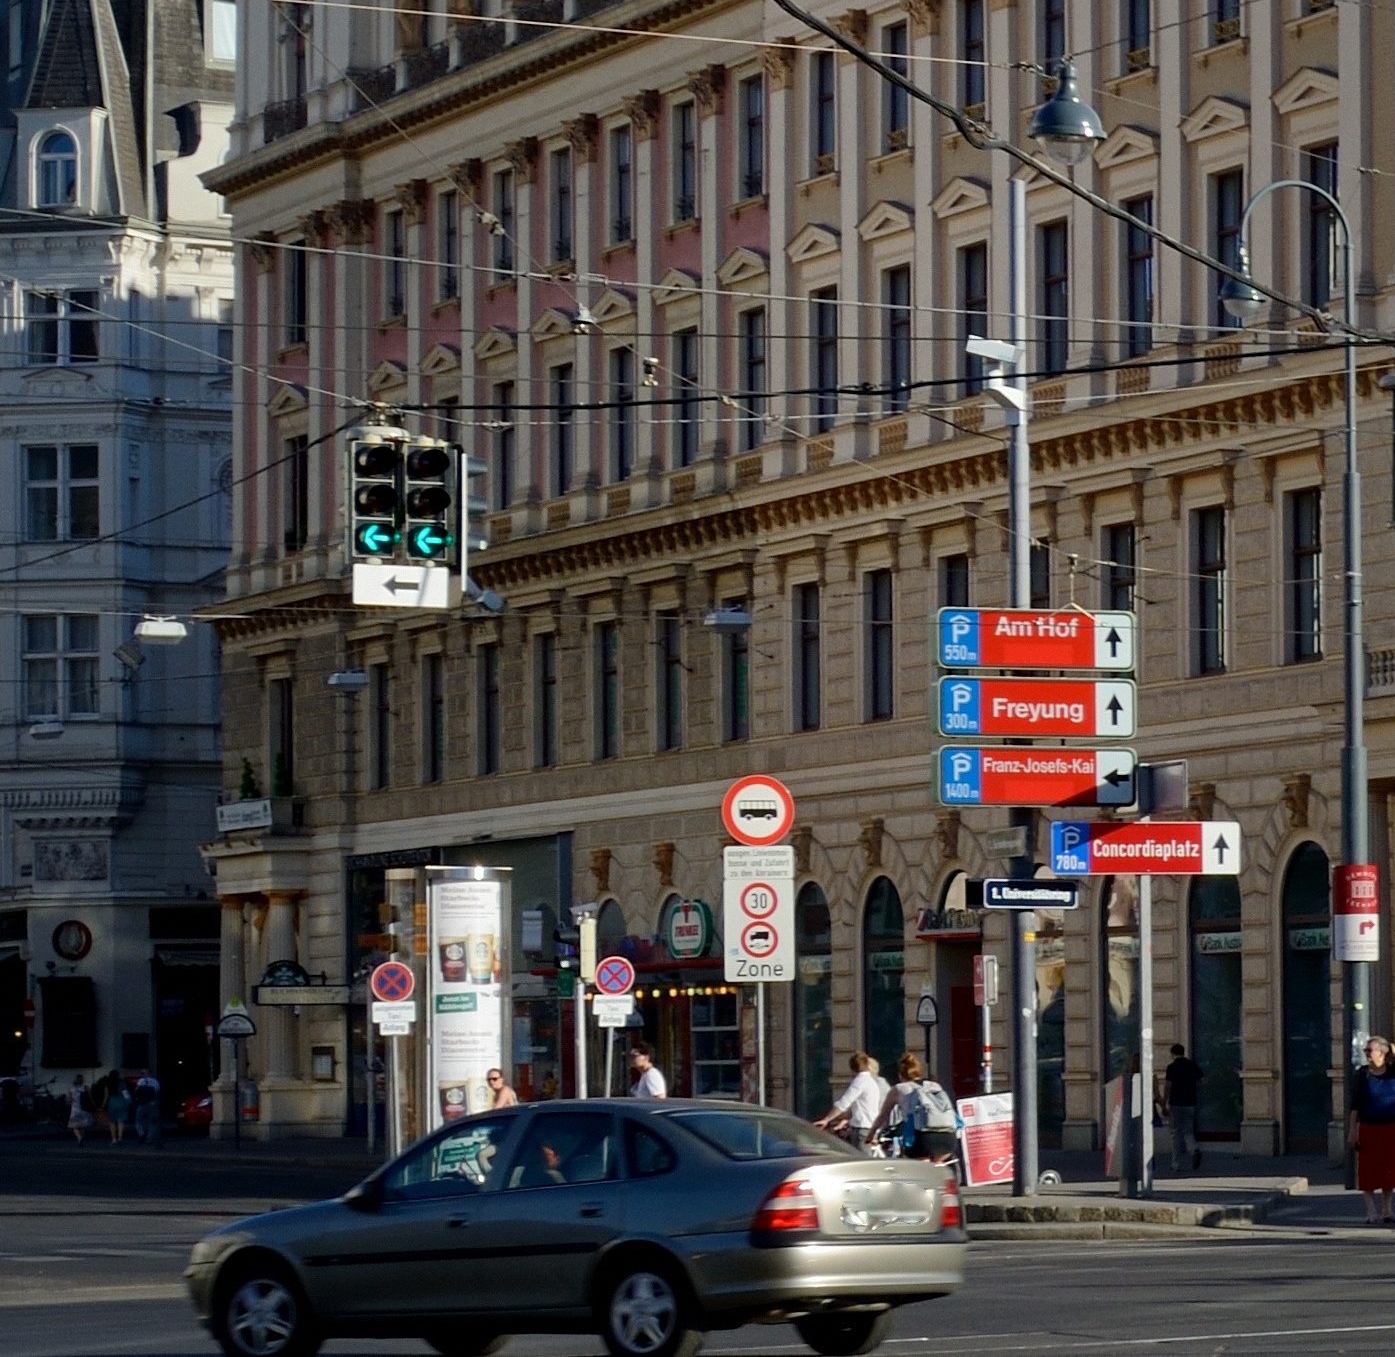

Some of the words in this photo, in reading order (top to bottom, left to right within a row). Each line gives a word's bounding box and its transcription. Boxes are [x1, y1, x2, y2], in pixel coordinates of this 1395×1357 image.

[994, 616, 1032, 637] Am
[1037, 617, 1079, 638] Hof
[992, 697, 1084, 723] Freyung
[983, 757, 1094, 774] Franz-Josefs-Kai
[1093, 839, 1200, 862] Concordiaplatz
[751, 893, 767, 909] 30
[736, 959, 783, 977] Zone
